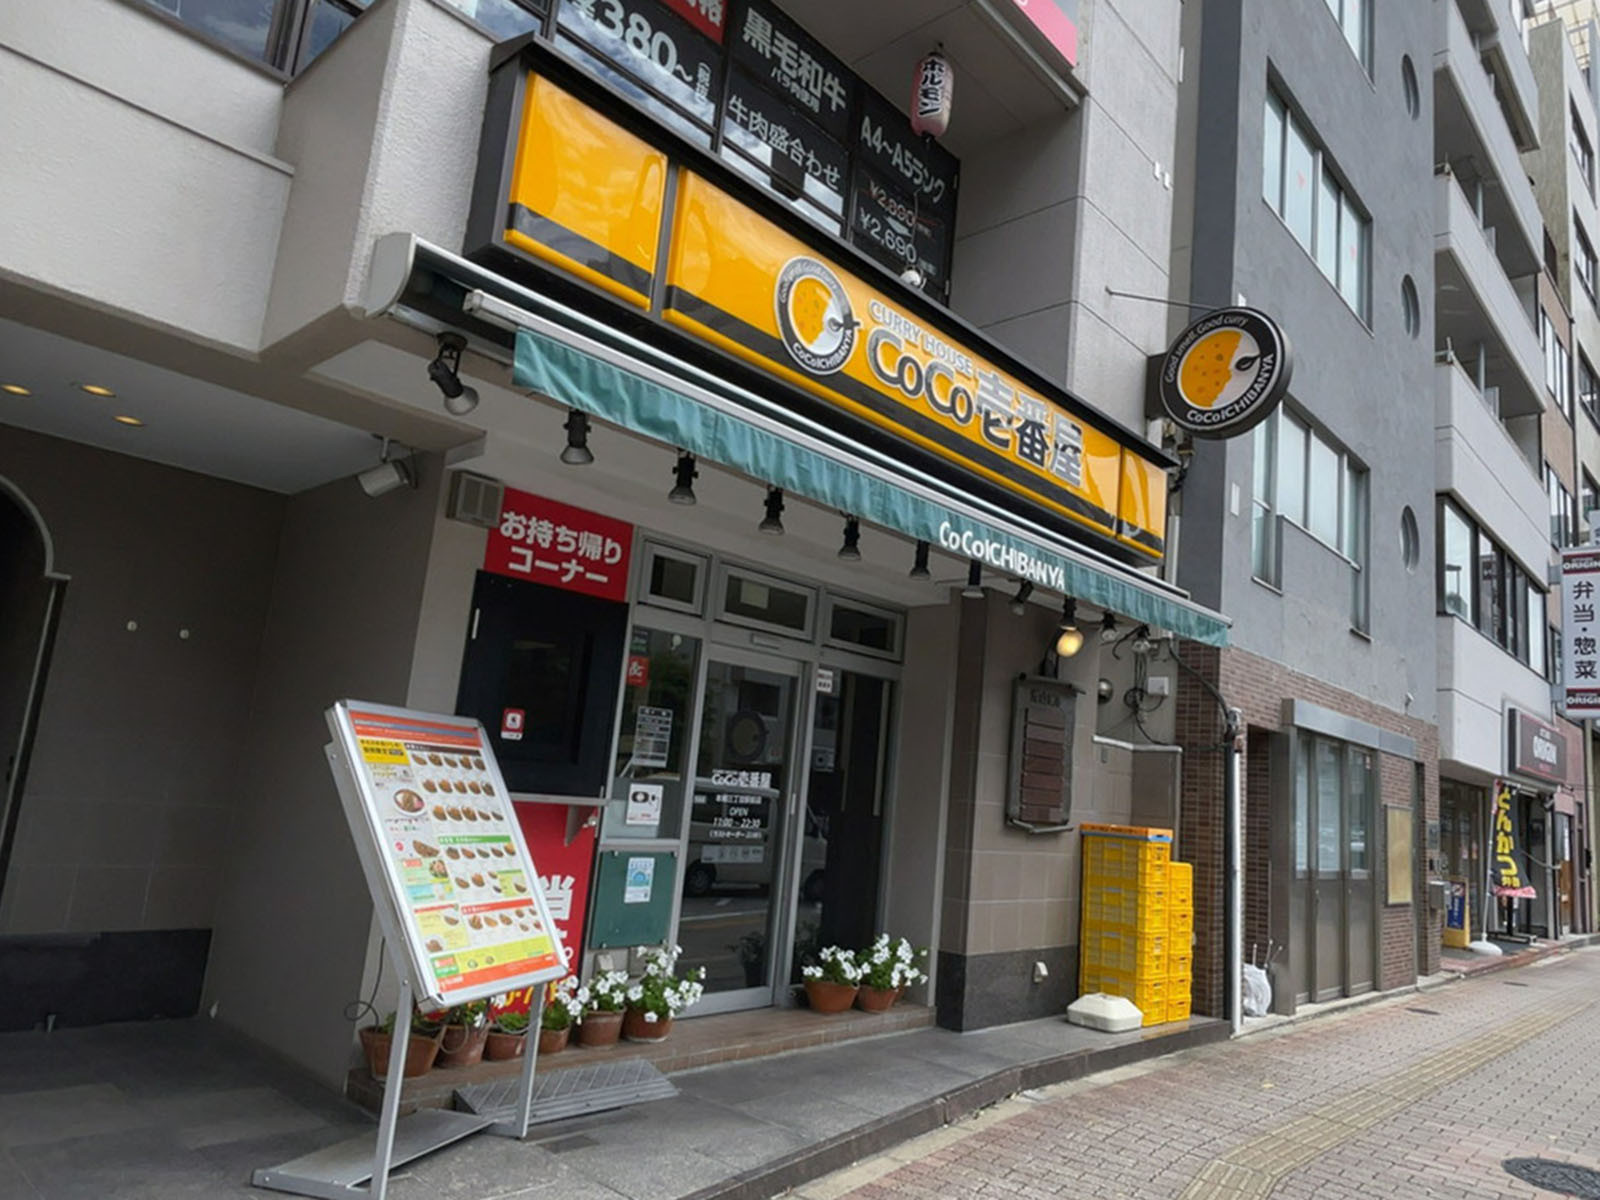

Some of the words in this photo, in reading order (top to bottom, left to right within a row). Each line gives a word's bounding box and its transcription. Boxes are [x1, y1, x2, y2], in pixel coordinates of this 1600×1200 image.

[742, 7, 846, 111] 黒毛和牛
[919, 57, 944, 116] ホルモン
[728, 95, 841, 191] 牛肉盛合わせ
[870, 301, 921, 342] CURRY
[924, 334, 974, 376] HOUSE
[1196, 314, 1224, 335] Good
[1186, 352, 1275, 424] CoCoICHIBANYA
[500, 511, 621, 565] お持ち帰り
[508, 546, 608, 584] コーナー
[1573, 580, 1598, 680] 弁当・惣菜
[729, 806, 749, 817] OPEN
